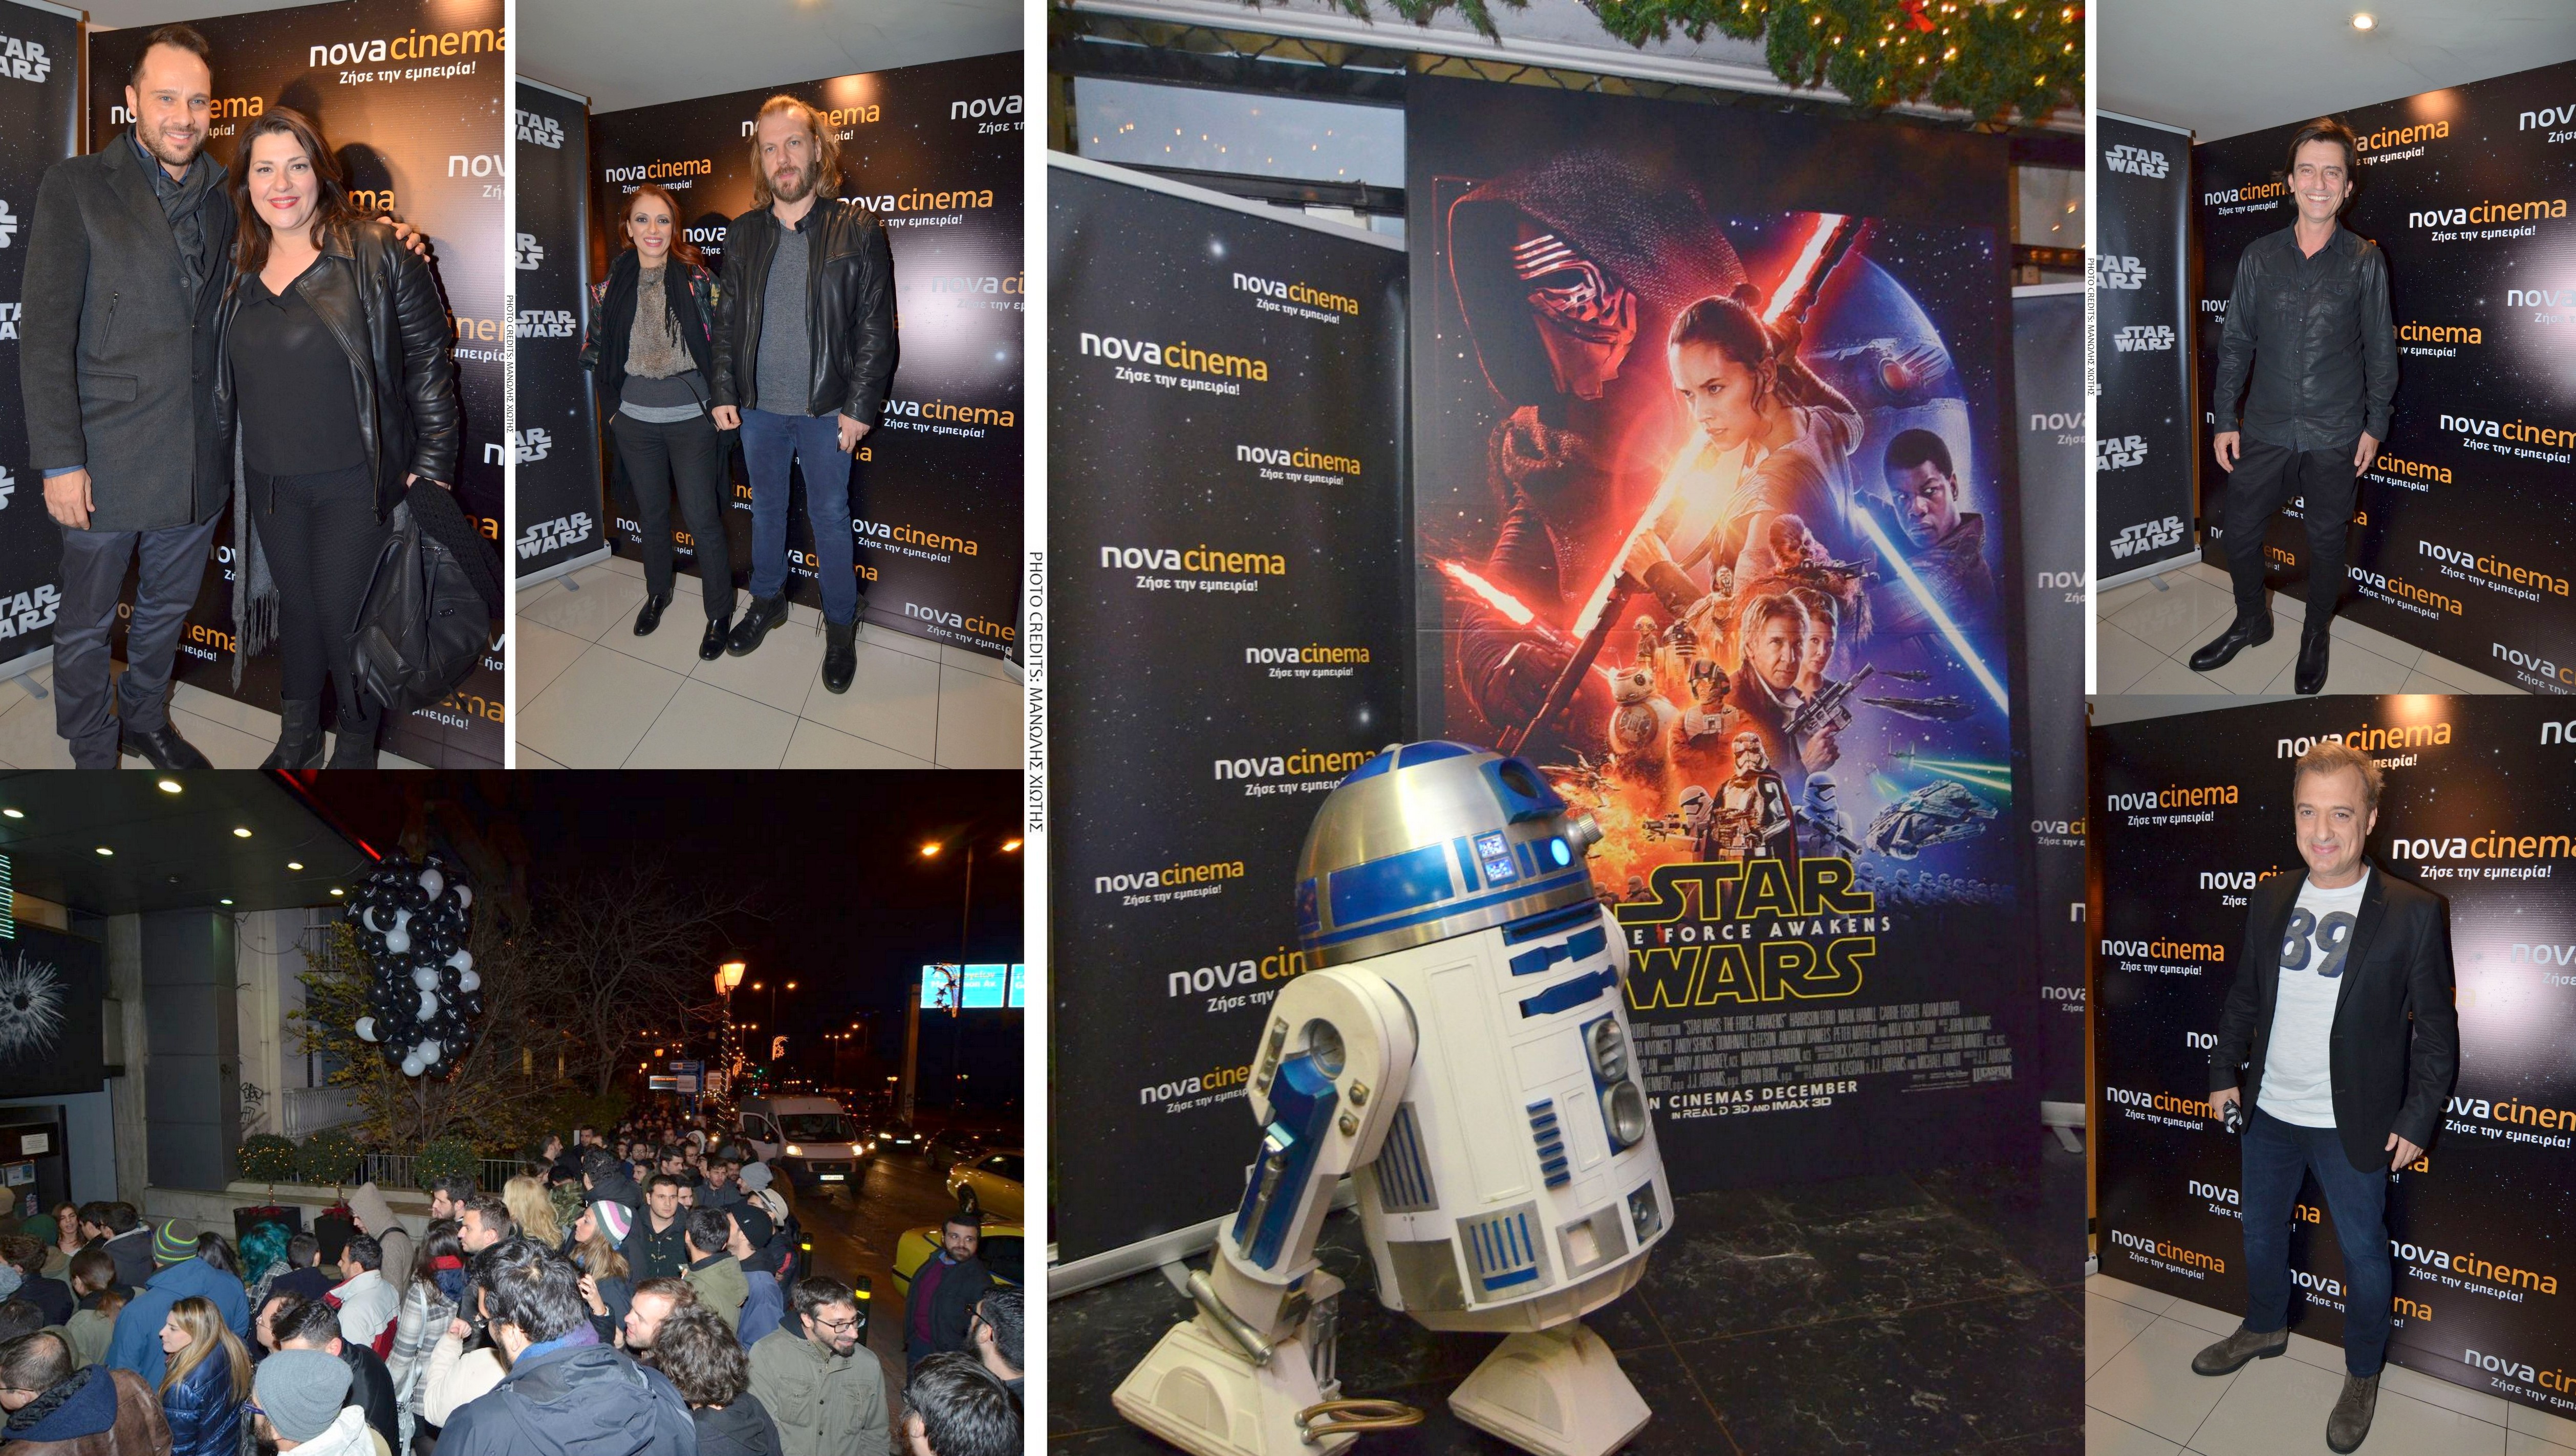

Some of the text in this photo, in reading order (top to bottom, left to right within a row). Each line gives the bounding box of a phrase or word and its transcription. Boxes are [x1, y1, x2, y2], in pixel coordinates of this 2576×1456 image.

[2105, 144, 2169, 167] STAR
[2105, 156, 2169, 179] WARS
[515, 324, 576, 338] WARS
[516, 310, 575, 324] STAR
[2114, 325, 2175, 339] STAR
[2115, 337, 2175, 352] WARS
[516, 512, 592, 546] STAR
[516, 523, 592, 559] WARS
[2110, 515, 2184, 547] STAR
[2111, 527, 2184, 560] WARS
[1614, 857, 1874, 925] STAR
[1665, 916, 1892, 944] FORCE AWAKENS
[2279, 907, 2357, 978] 89
[1627, 936, 1876, 1010] WARS
[1650, 1080, 1857, 1110] N CINEMAS DECEMBER
[1733, 1105, 1749, 1114] 3D
[1773, 1100, 1808, 1110] IMAX
[1812, 1097, 1831, 1106] 3D
